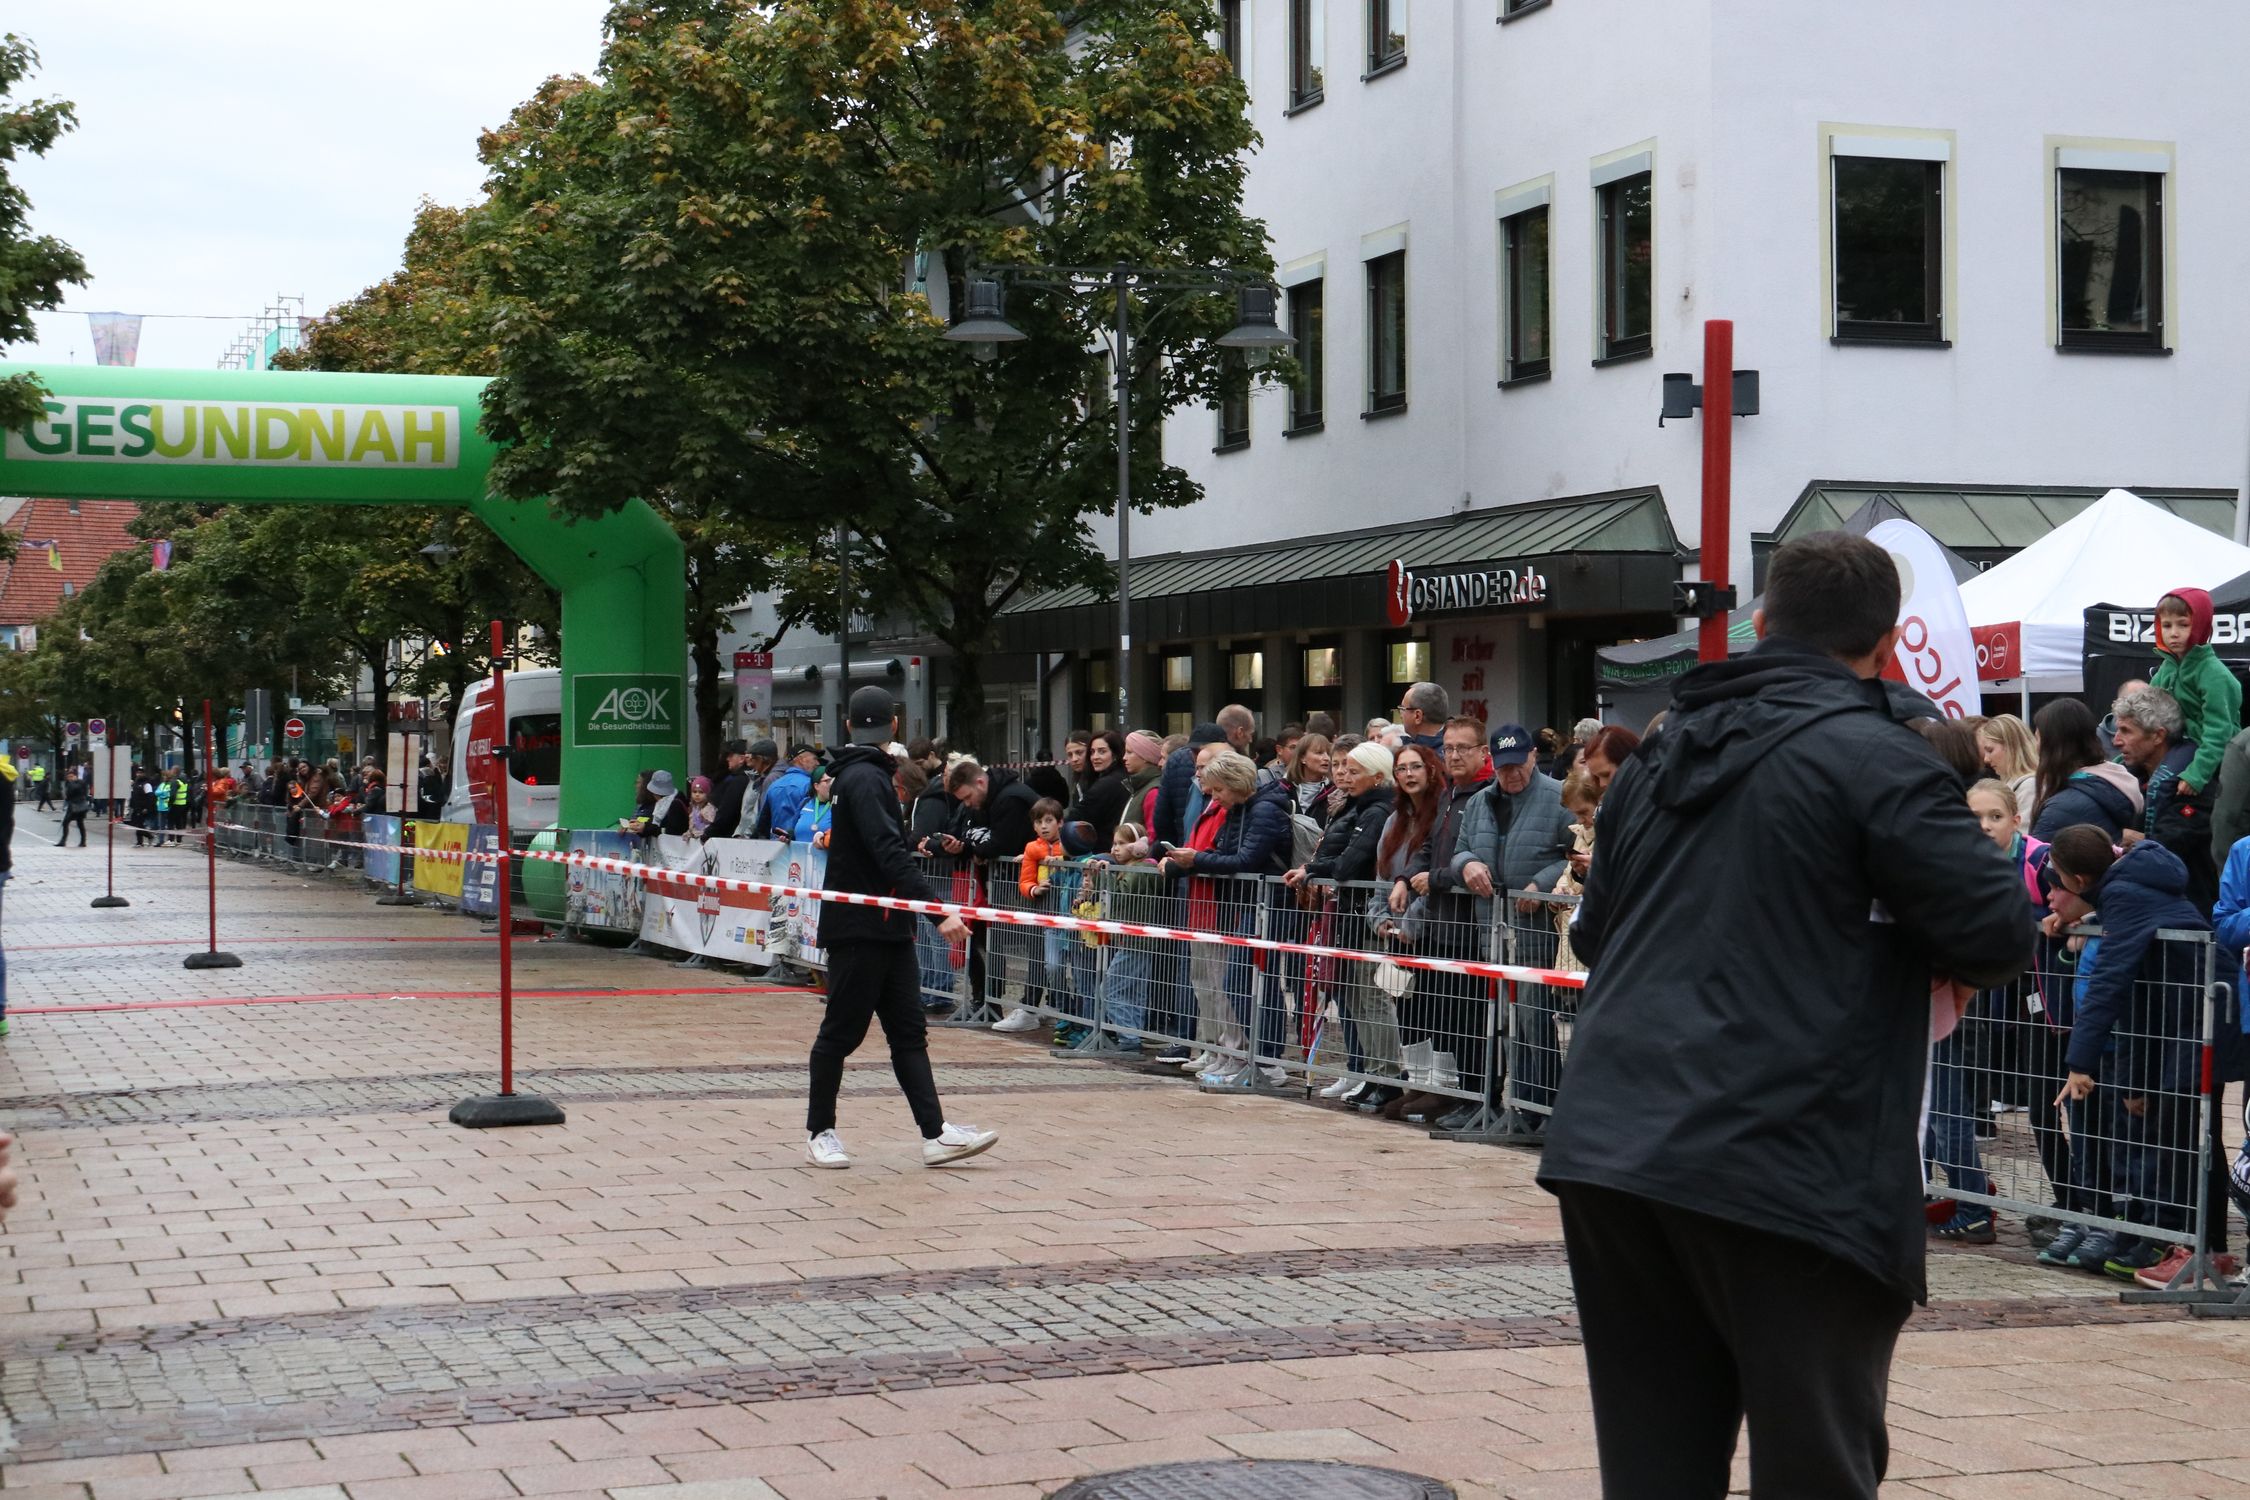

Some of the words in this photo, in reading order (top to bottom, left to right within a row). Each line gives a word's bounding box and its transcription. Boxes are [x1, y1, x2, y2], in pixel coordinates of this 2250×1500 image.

[23, 401, 445, 463] GESUNDNAH
[1412, 566, 1546, 611] OSIANDER.de
[590, 687, 670, 721] AOK
[588, 722, 600, 731] Die
